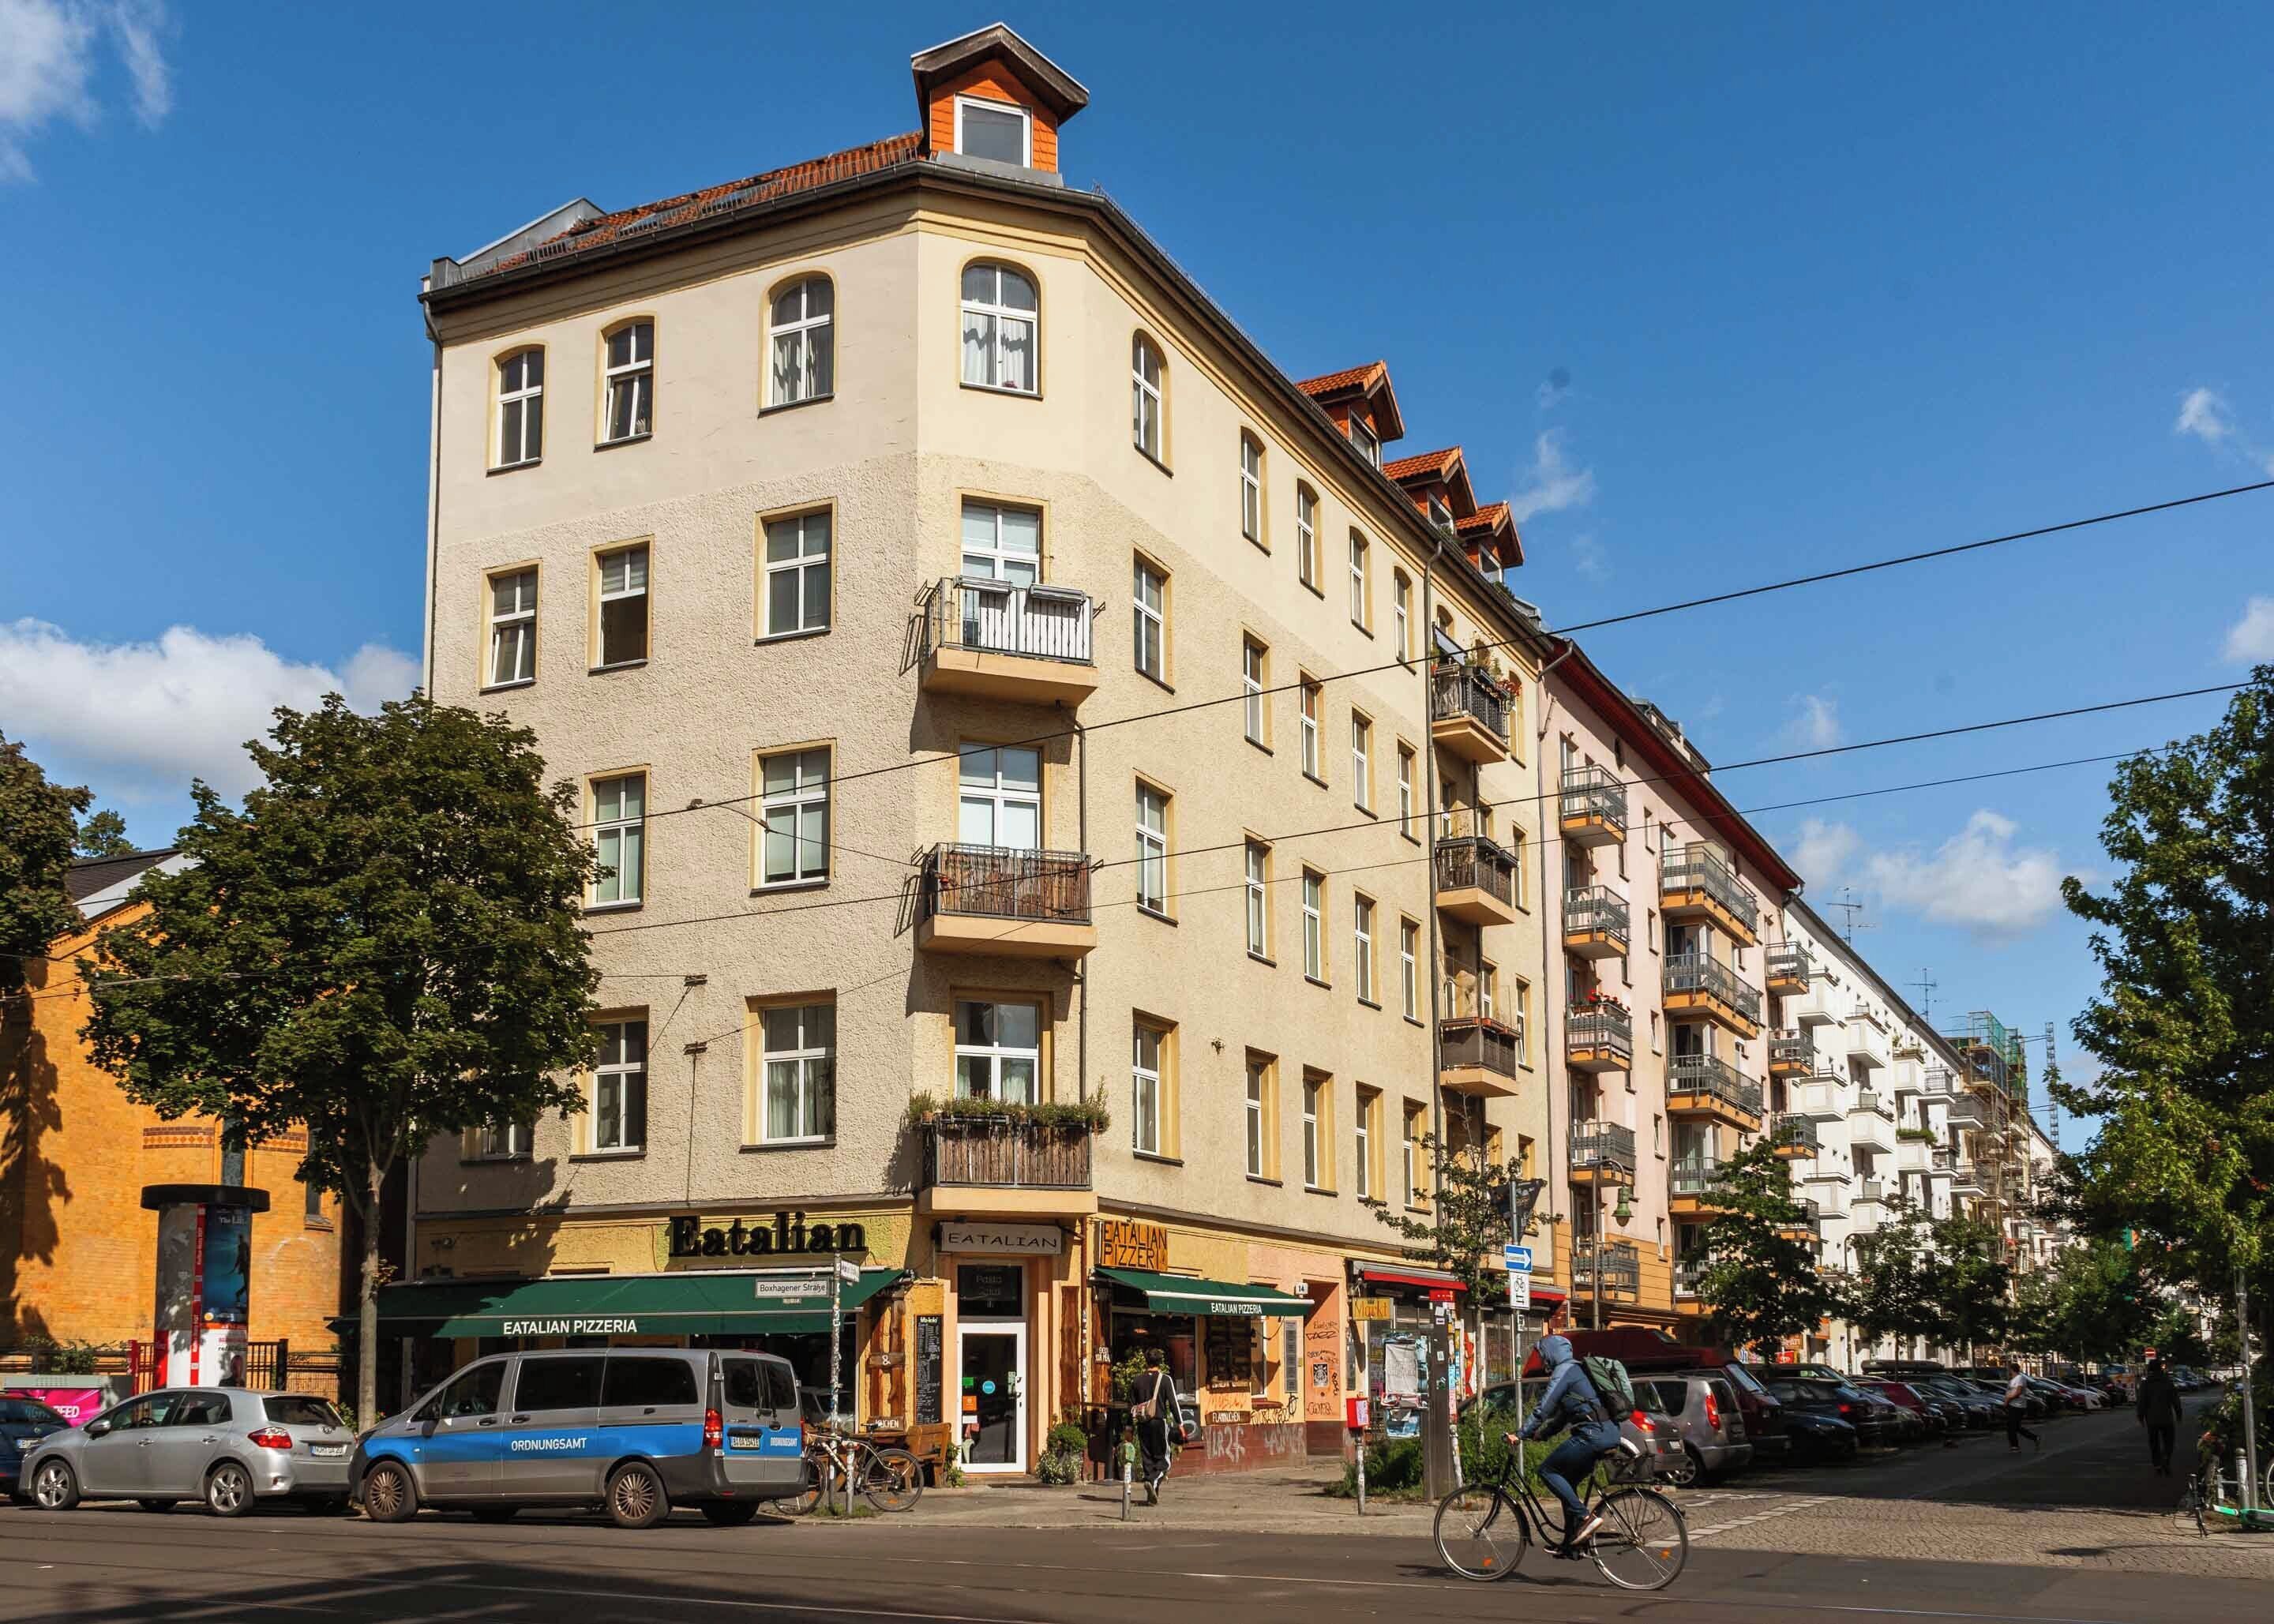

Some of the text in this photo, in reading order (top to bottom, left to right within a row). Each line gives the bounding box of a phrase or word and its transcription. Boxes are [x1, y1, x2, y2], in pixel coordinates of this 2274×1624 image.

[669, 1211, 869, 1257] Eatalian
[948, 1232, 1057, 1248] EATALIAN
[1104, 1221, 1167, 1250] EATALIAN
[1104, 1243, 1167, 1270] PIZZERI
[760, 1283, 826, 1293] Boxhagener Straße
[1210, 1302, 1263, 1315] EATALIAN PIZZERIA
[1354, 1300, 1388, 1317] Markt
[503, 1319, 638, 1335] EATALIAN PIZZERIA
[882, 1354, 891, 1366] &
[511, 1437, 587, 1451] ORDNUNGSAMT
